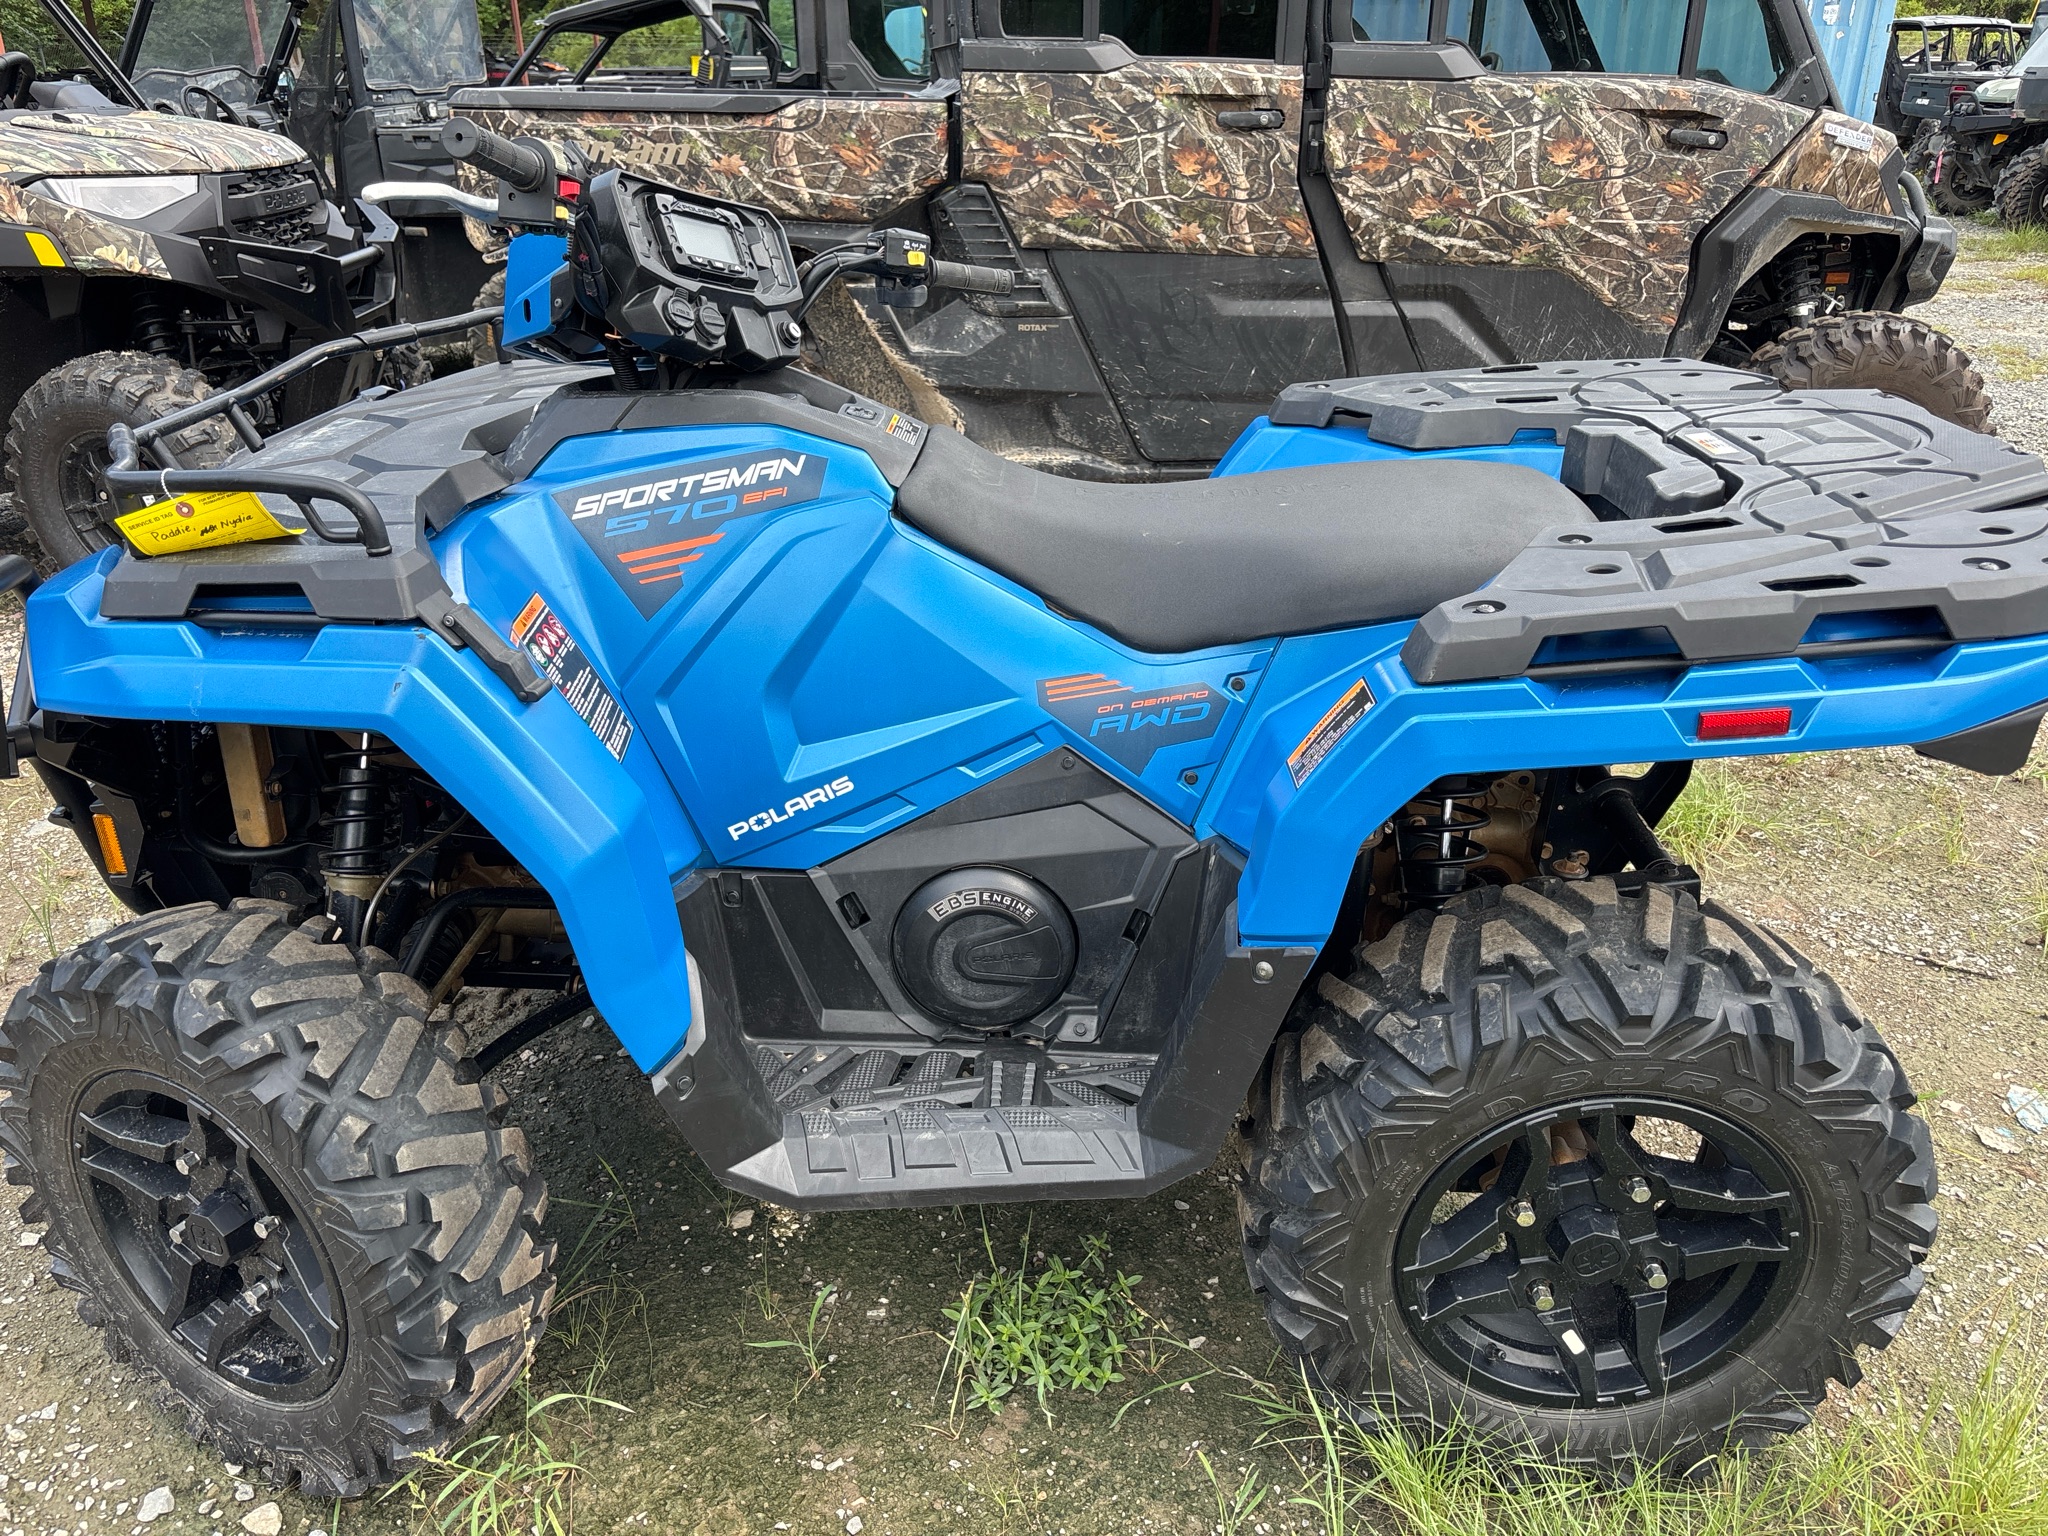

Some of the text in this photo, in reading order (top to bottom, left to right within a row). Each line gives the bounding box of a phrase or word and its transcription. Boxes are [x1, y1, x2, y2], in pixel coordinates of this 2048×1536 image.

[1827, 125, 1872, 144] DEFENDER
[578, 140, 691, 166] n-am
[1017, 324, 1048, 332] ROTAX
[572, 455, 806, 520] SPORTSMAN
[127, 519, 154, 531] SERVICE
[160, 512, 174, 521] TAG
[604, 487, 788, 538] 570 EFI
[1097, 690, 1209, 714] ON DEMAND
[1089, 702, 1211, 737] AWD
[1311, 700, 1345, 735] WARNING
[727, 775, 855, 841] POLARIS
[933, 891, 1035, 918] EBS ENGINE
[971, 951, 1035, 965] POLARIS
[1544, 1067, 1773, 1114] DURO
